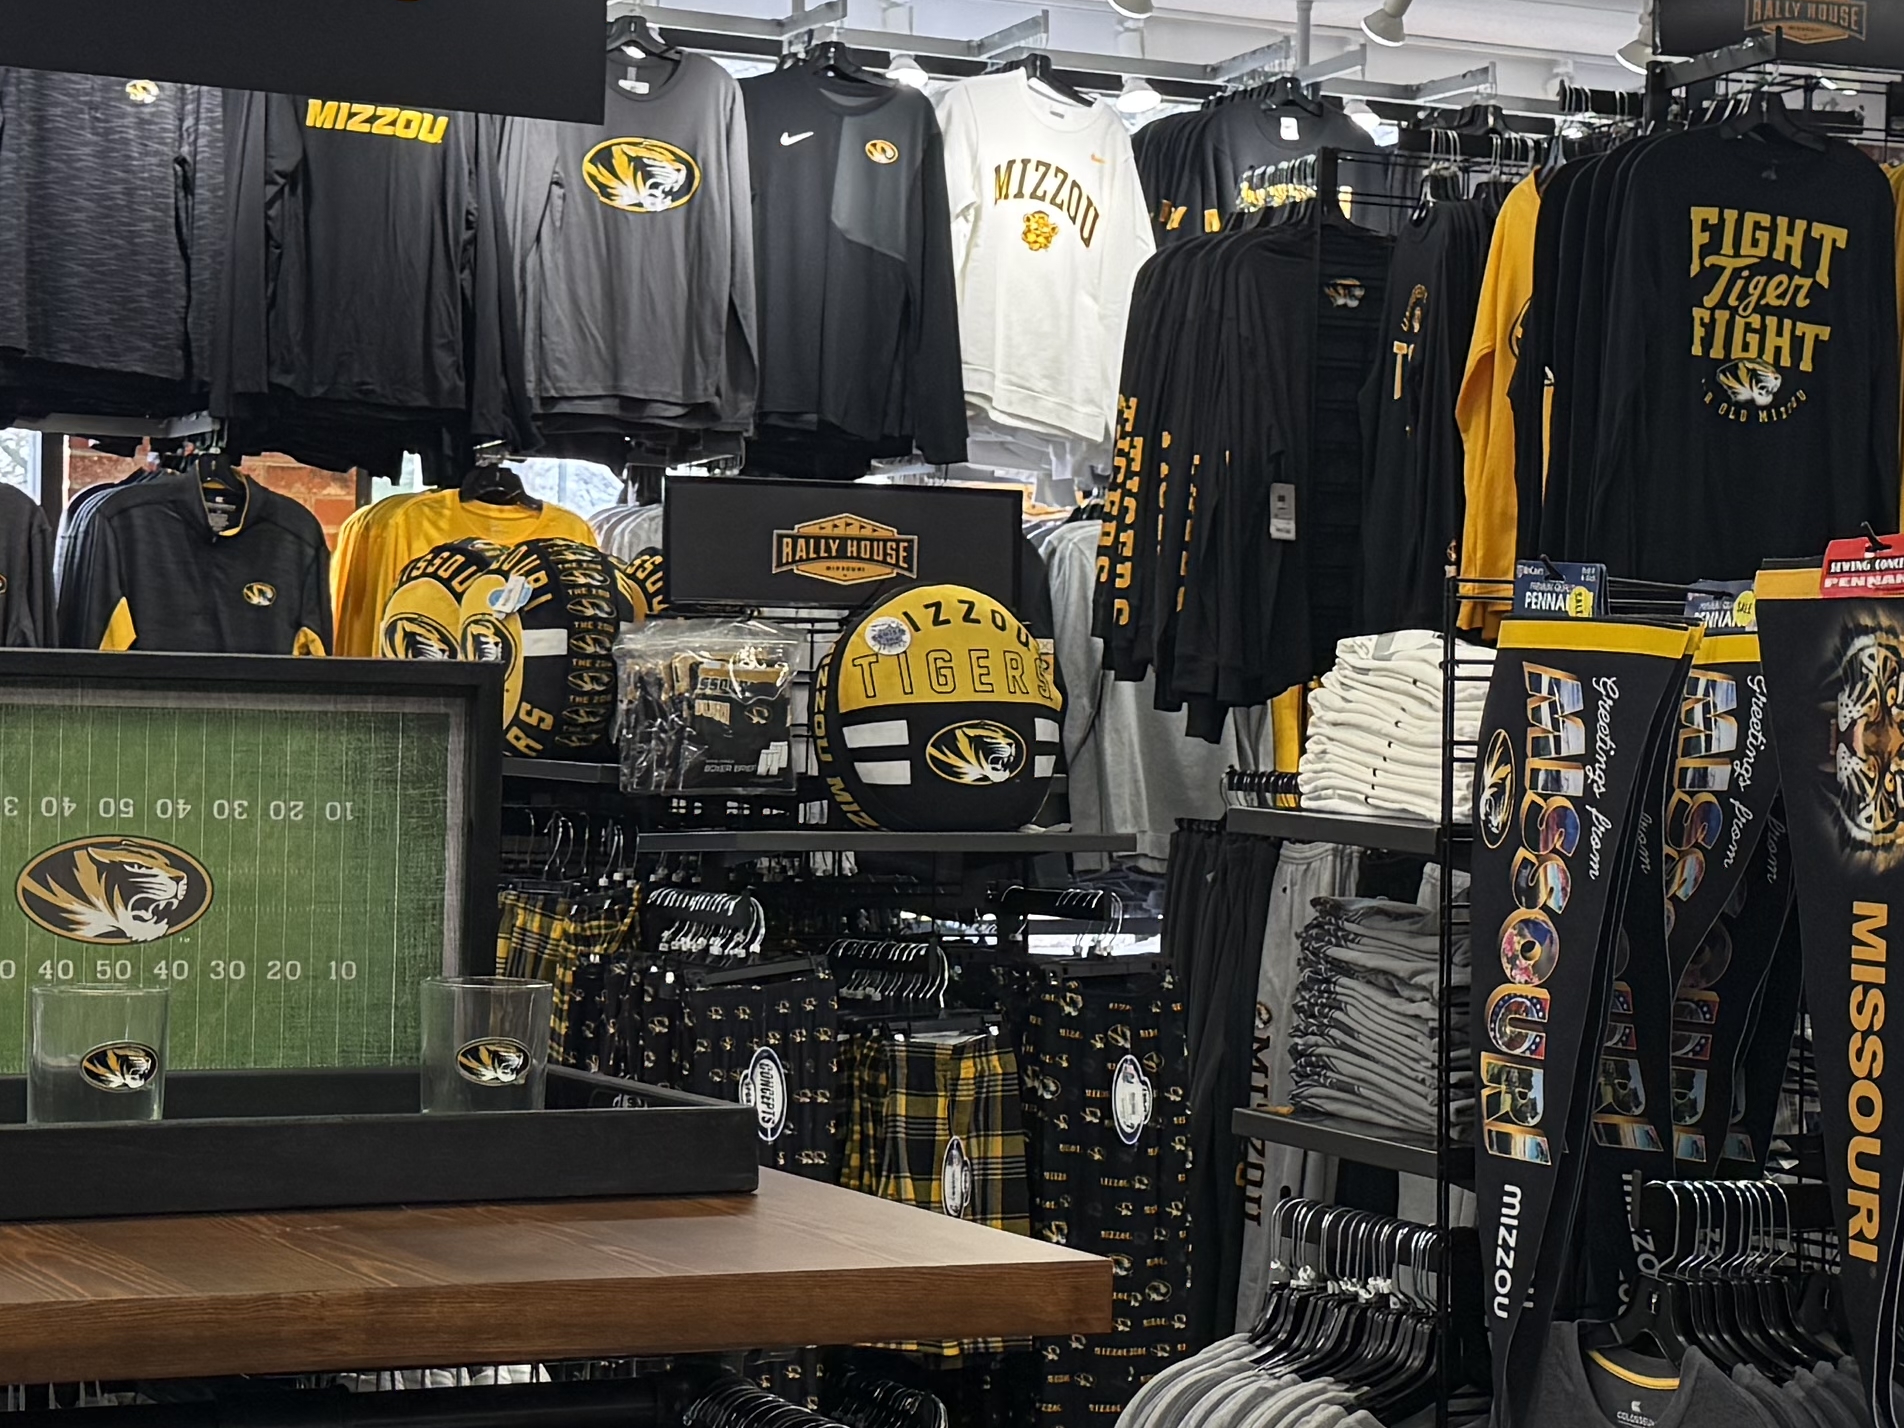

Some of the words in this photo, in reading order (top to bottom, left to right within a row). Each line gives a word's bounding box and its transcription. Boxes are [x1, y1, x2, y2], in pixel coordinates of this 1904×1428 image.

[1807, 2, 1859, 30] HOUSE
[305, 98, 449, 144] MIZZOU
[994, 158, 1101, 249] MIZZOU
[1690, 206, 1848, 289] FIGHT
[1703, 255, 1816, 317] Tiger
[1691, 307, 1831, 372] FIGHT
[782, 537, 840, 564] RALLY
[847, 539, 909, 568] HOUSE
[1830, 558, 1872, 573] SEWING
[902, 599, 1030, 648] IZZOU
[1524, 591, 1570, 611] PENNA
[852, 648, 1054, 702] TIGERS
[1590, 675, 1618, 802] Greetings
[1733, 675, 1765, 798] Greetings
[1586, 803, 1610, 882] from
[1723, 797, 1757, 869] from
[1480, 660, 1589, 1167] MISSOURI
[38, 959, 74, 981] 40
[96, 959, 132, 981] 50
[154, 959, 189, 981] 40
[210, 959, 246, 981] 30
[266, 959, 301, 981] 20
[329, 959, 357, 981] 10
[759, 1062, 776, 1125] CONCEPTS
[1848, 899, 1889, 1263] MISSOURI
[1245, 1035, 1272, 1227] MIZOU
[1493, 1183, 1522, 1319] MIZZOU
